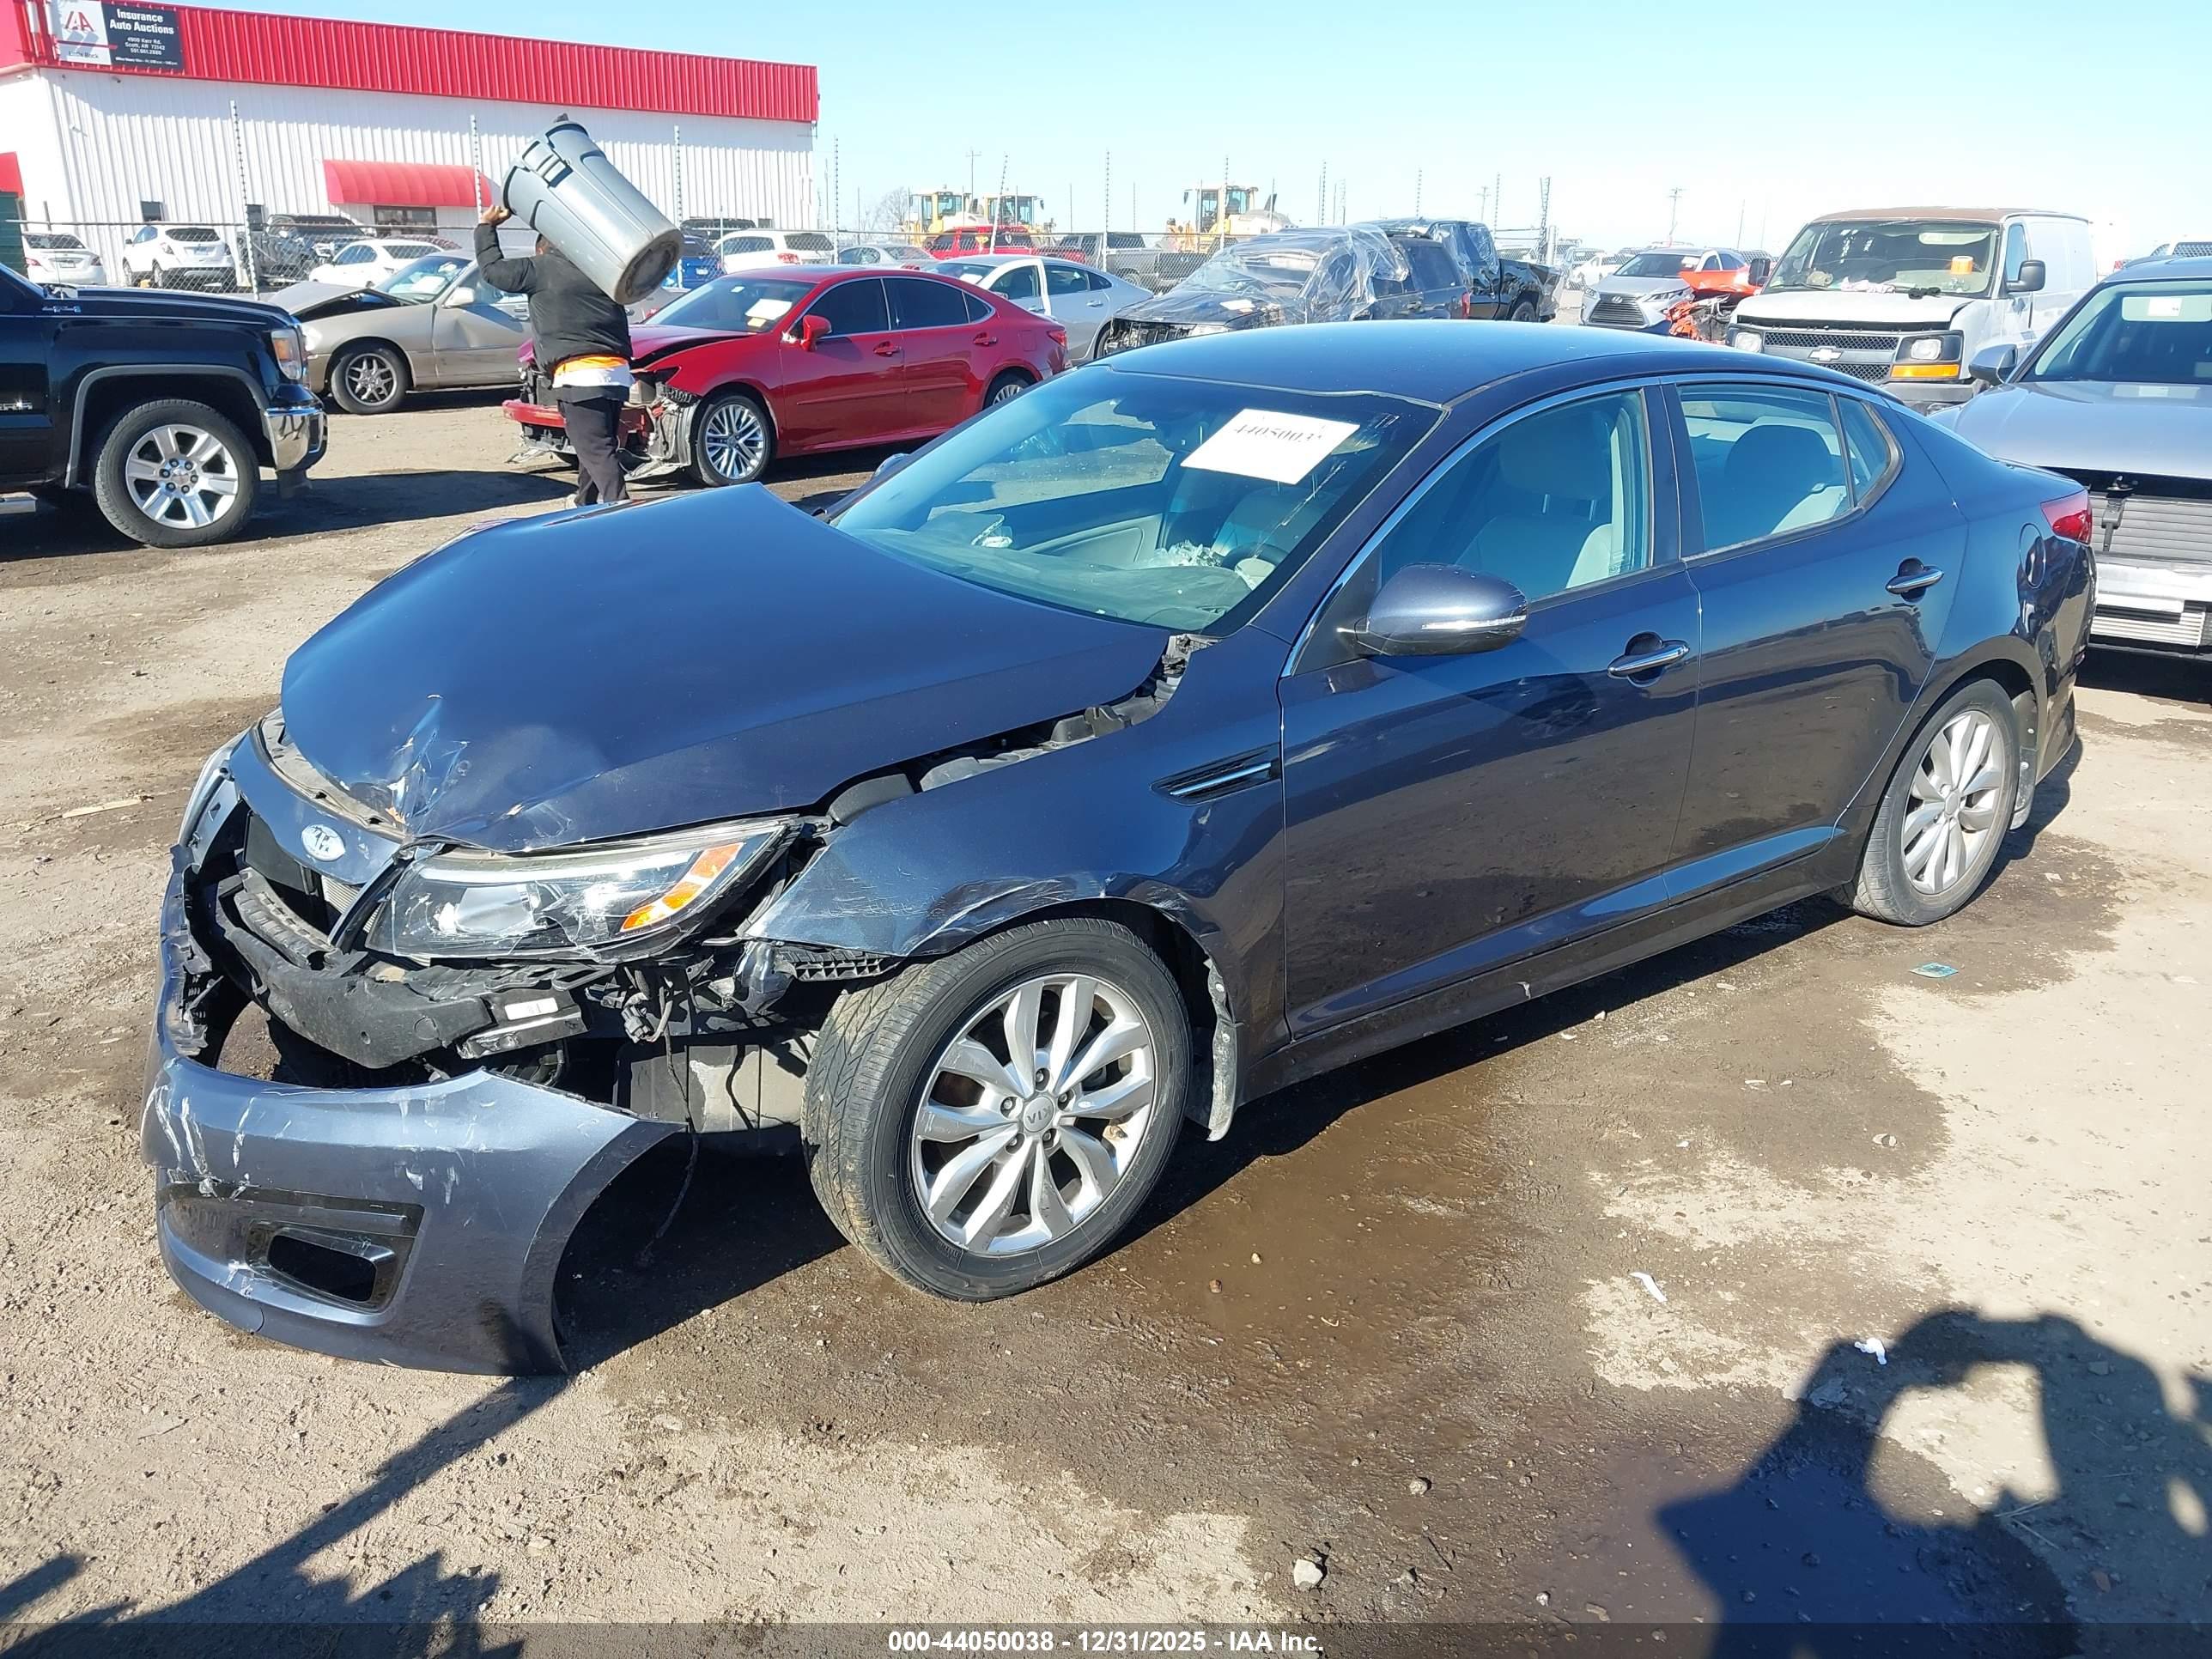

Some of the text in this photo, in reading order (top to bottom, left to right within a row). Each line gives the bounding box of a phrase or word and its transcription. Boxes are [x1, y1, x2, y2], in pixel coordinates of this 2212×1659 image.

[117, 9, 164, 23] Insurance
[109, 19, 174, 35] Auto Auctions
